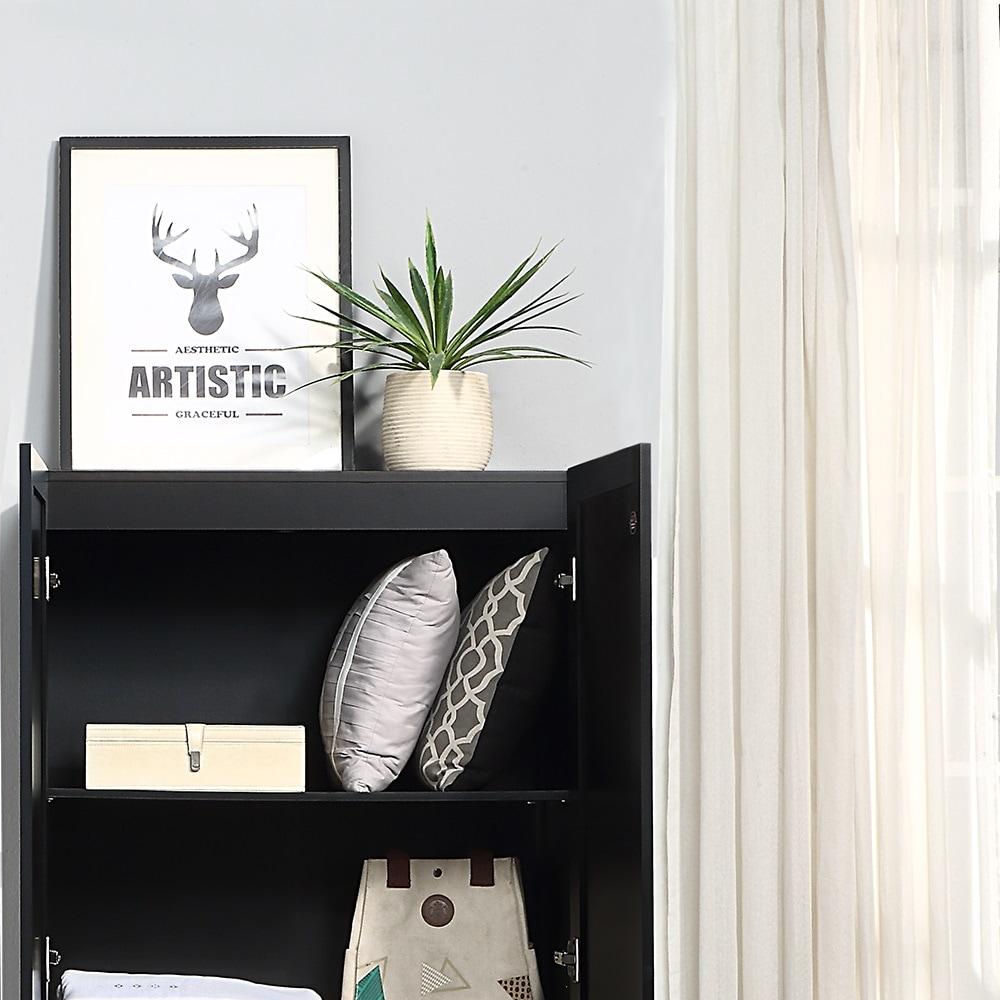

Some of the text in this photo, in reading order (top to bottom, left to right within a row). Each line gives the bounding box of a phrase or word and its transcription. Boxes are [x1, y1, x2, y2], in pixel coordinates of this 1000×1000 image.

[175, 346, 239, 354] AESTHETIC
[128, 364, 286, 398] ARTISTIC
[175, 410, 239, 419] GRACEFUL
